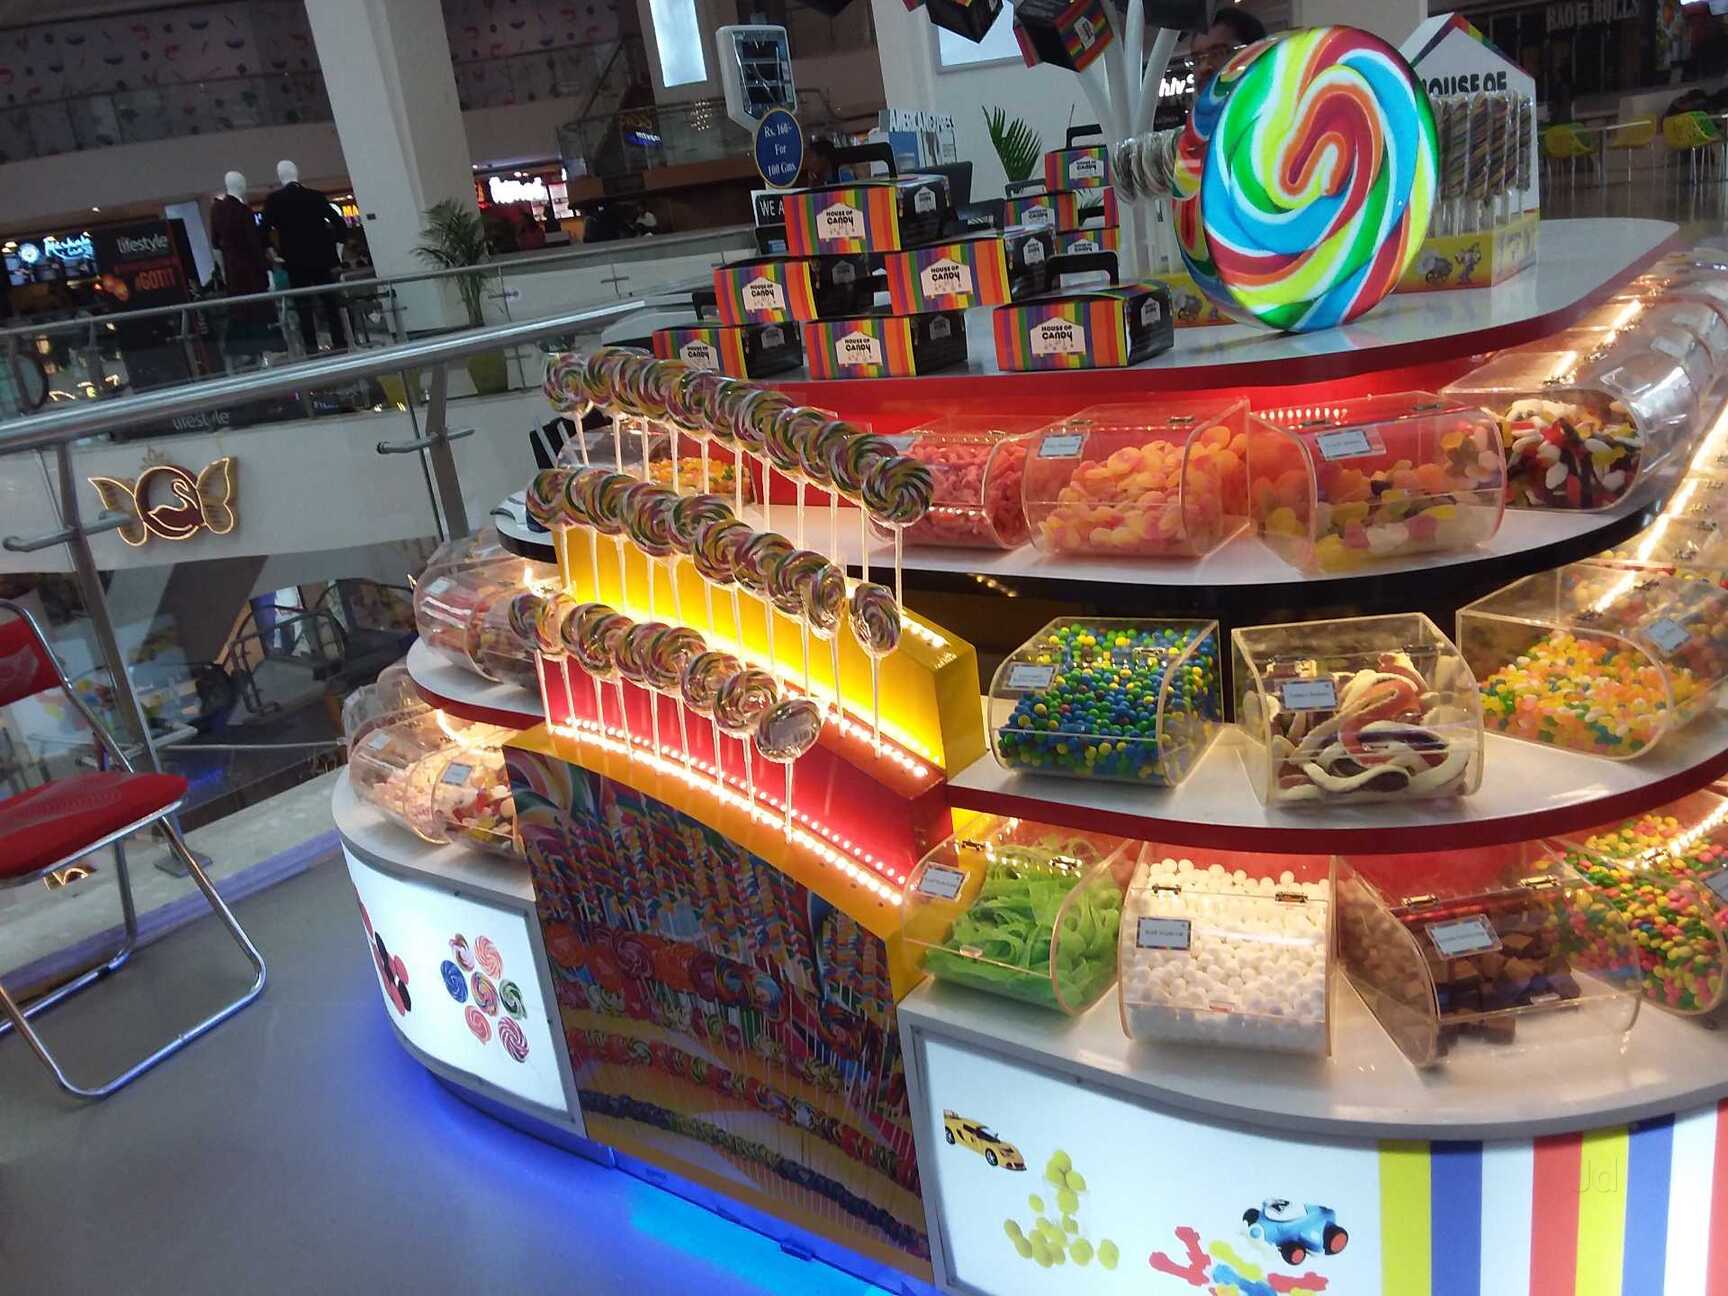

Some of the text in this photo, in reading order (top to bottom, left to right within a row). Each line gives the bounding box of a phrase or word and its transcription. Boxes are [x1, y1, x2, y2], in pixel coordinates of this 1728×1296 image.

[1422, 74, 1480, 95] OUSE
[774, 143, 787, 156] For
[760, 200, 776, 216] WE
[827, 215, 854, 226] CANDY
[931, 266, 950, 274] HOUSE
[931, 271, 960, 283] CANDY
[751, 288, 775, 299] CANDY
[1041, 331, 1073, 342] CANDY
[845, 343, 871, 354] CANDY
